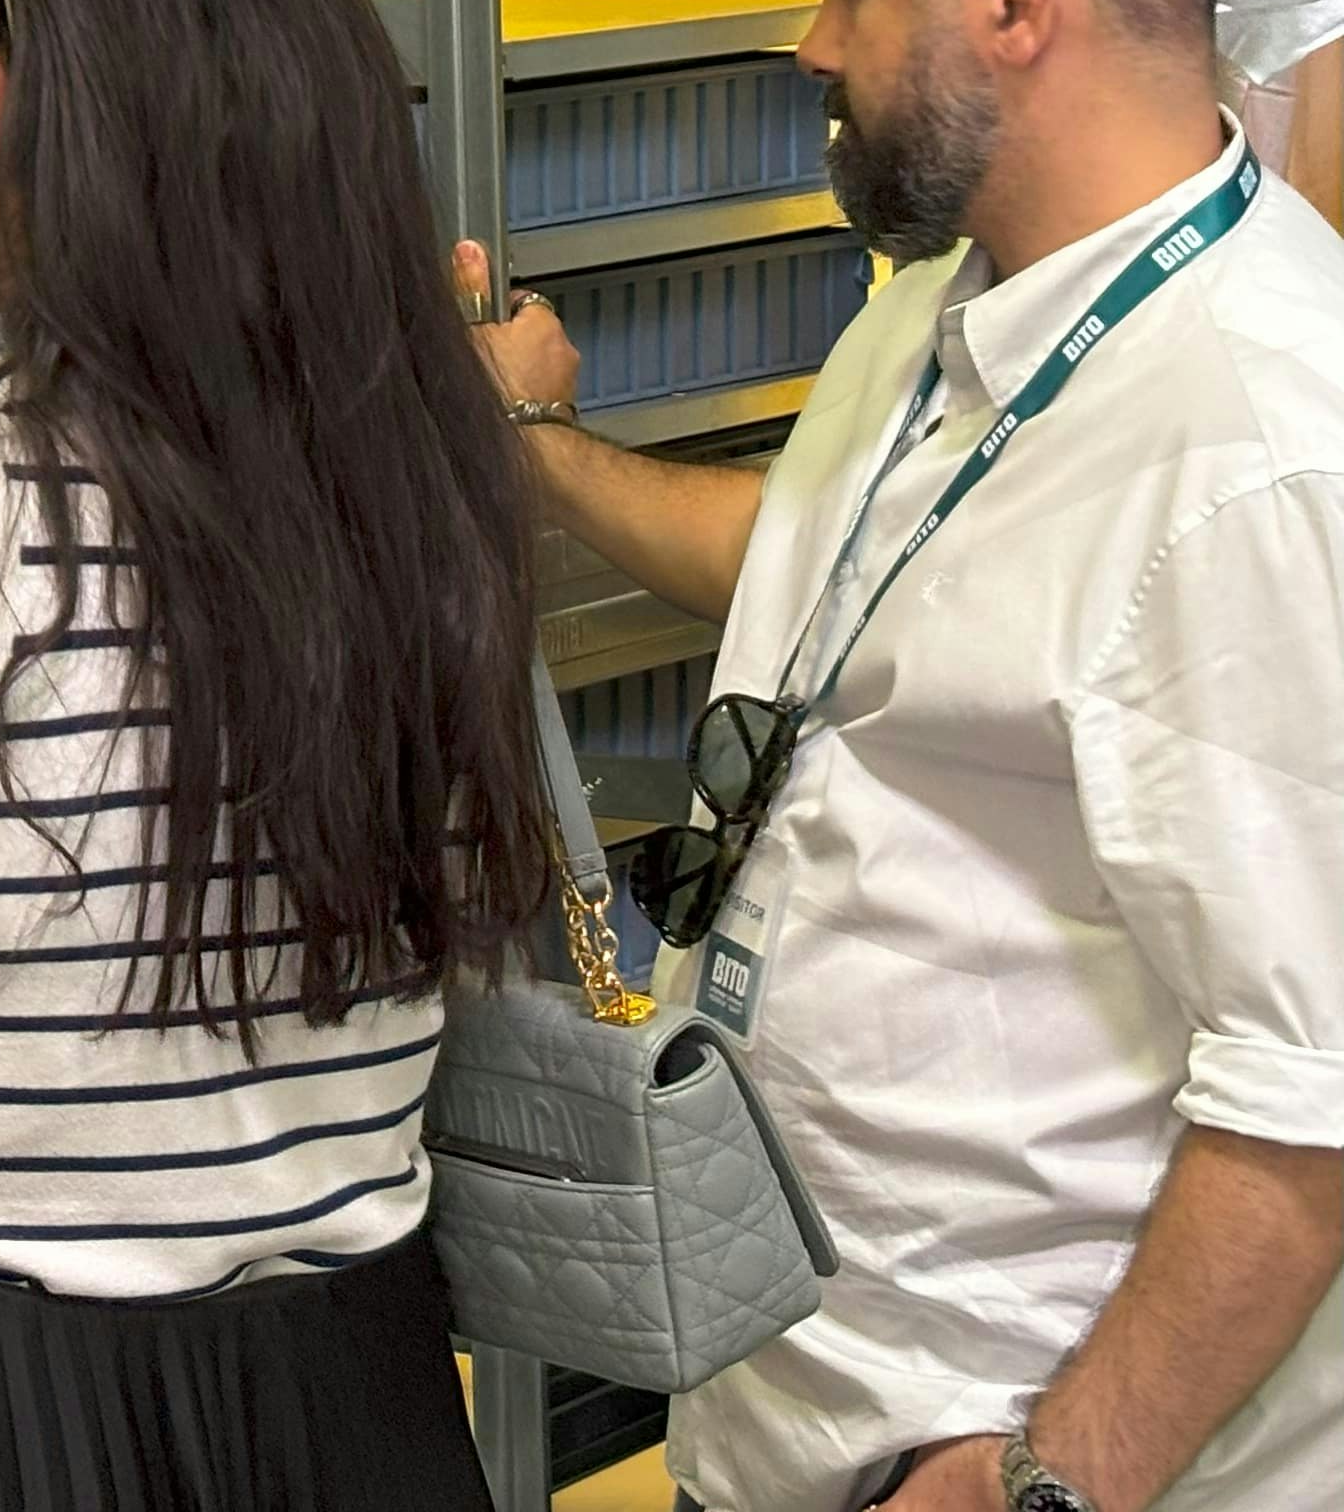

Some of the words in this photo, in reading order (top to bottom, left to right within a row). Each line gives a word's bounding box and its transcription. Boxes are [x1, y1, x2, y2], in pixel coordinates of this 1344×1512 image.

[1151, 223, 1205, 272] BITO
[1060, 314, 1106, 364] BITO
[980, 412, 1018, 460] BITO
[711, 951, 751, 998] BITO
